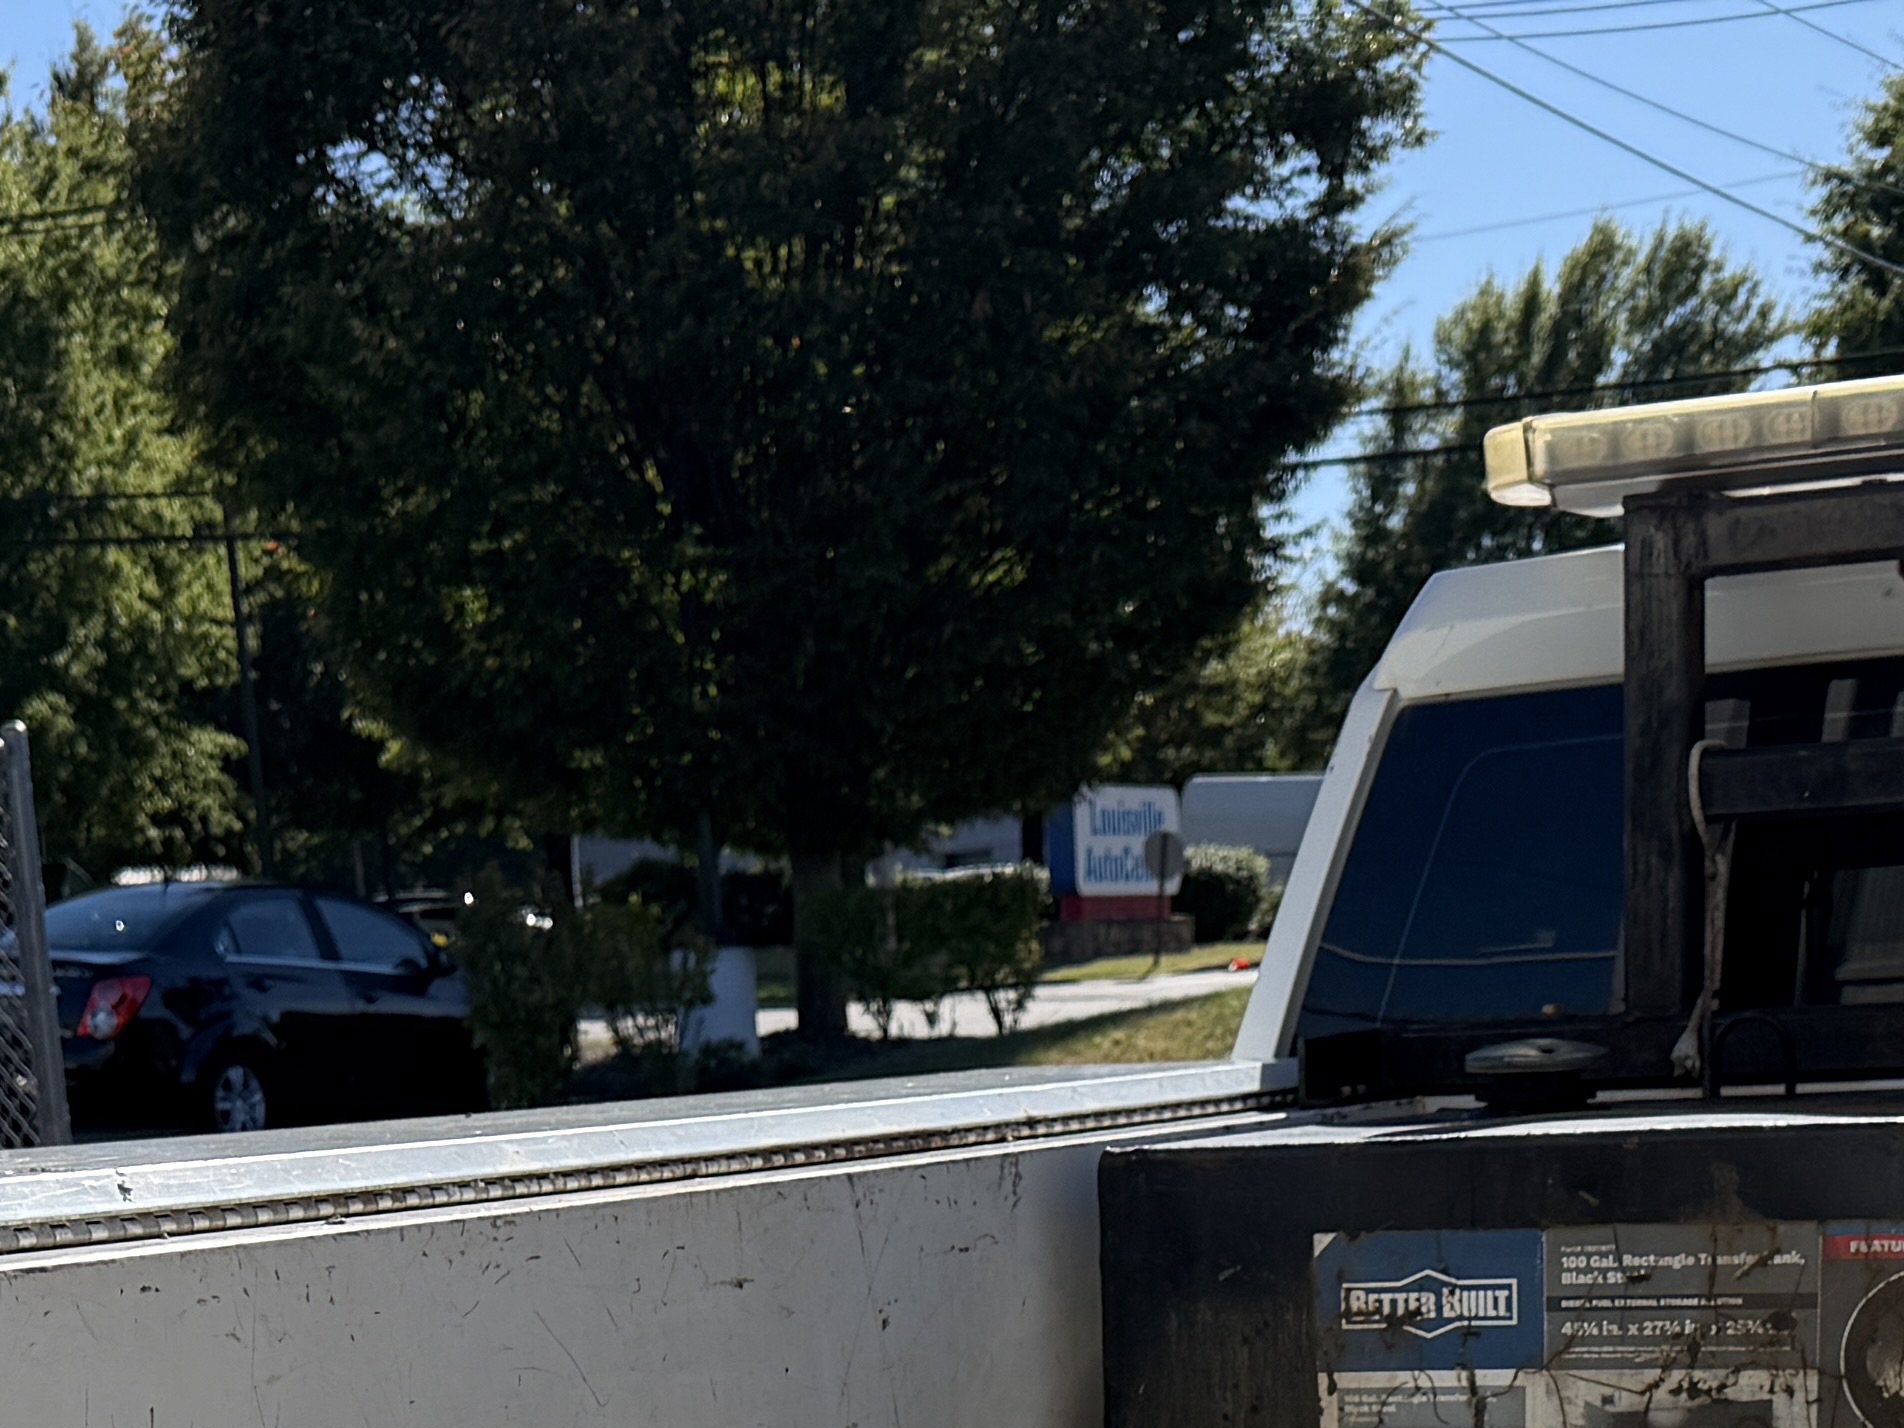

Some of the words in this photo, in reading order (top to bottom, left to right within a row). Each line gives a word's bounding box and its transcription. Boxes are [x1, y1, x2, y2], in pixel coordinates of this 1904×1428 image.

[1089, 800, 1165, 837] Louisville
[1086, 845, 1156, 883] AutoCa
[1561, 1256, 1587, 1269] 100
[1590, 1254, 1619, 1268] Gal.
[1561, 1271, 1604, 1286] Black
[1349, 1289, 1436, 1319] BETTER
[1442, 1286, 1511, 1319] BUILT
